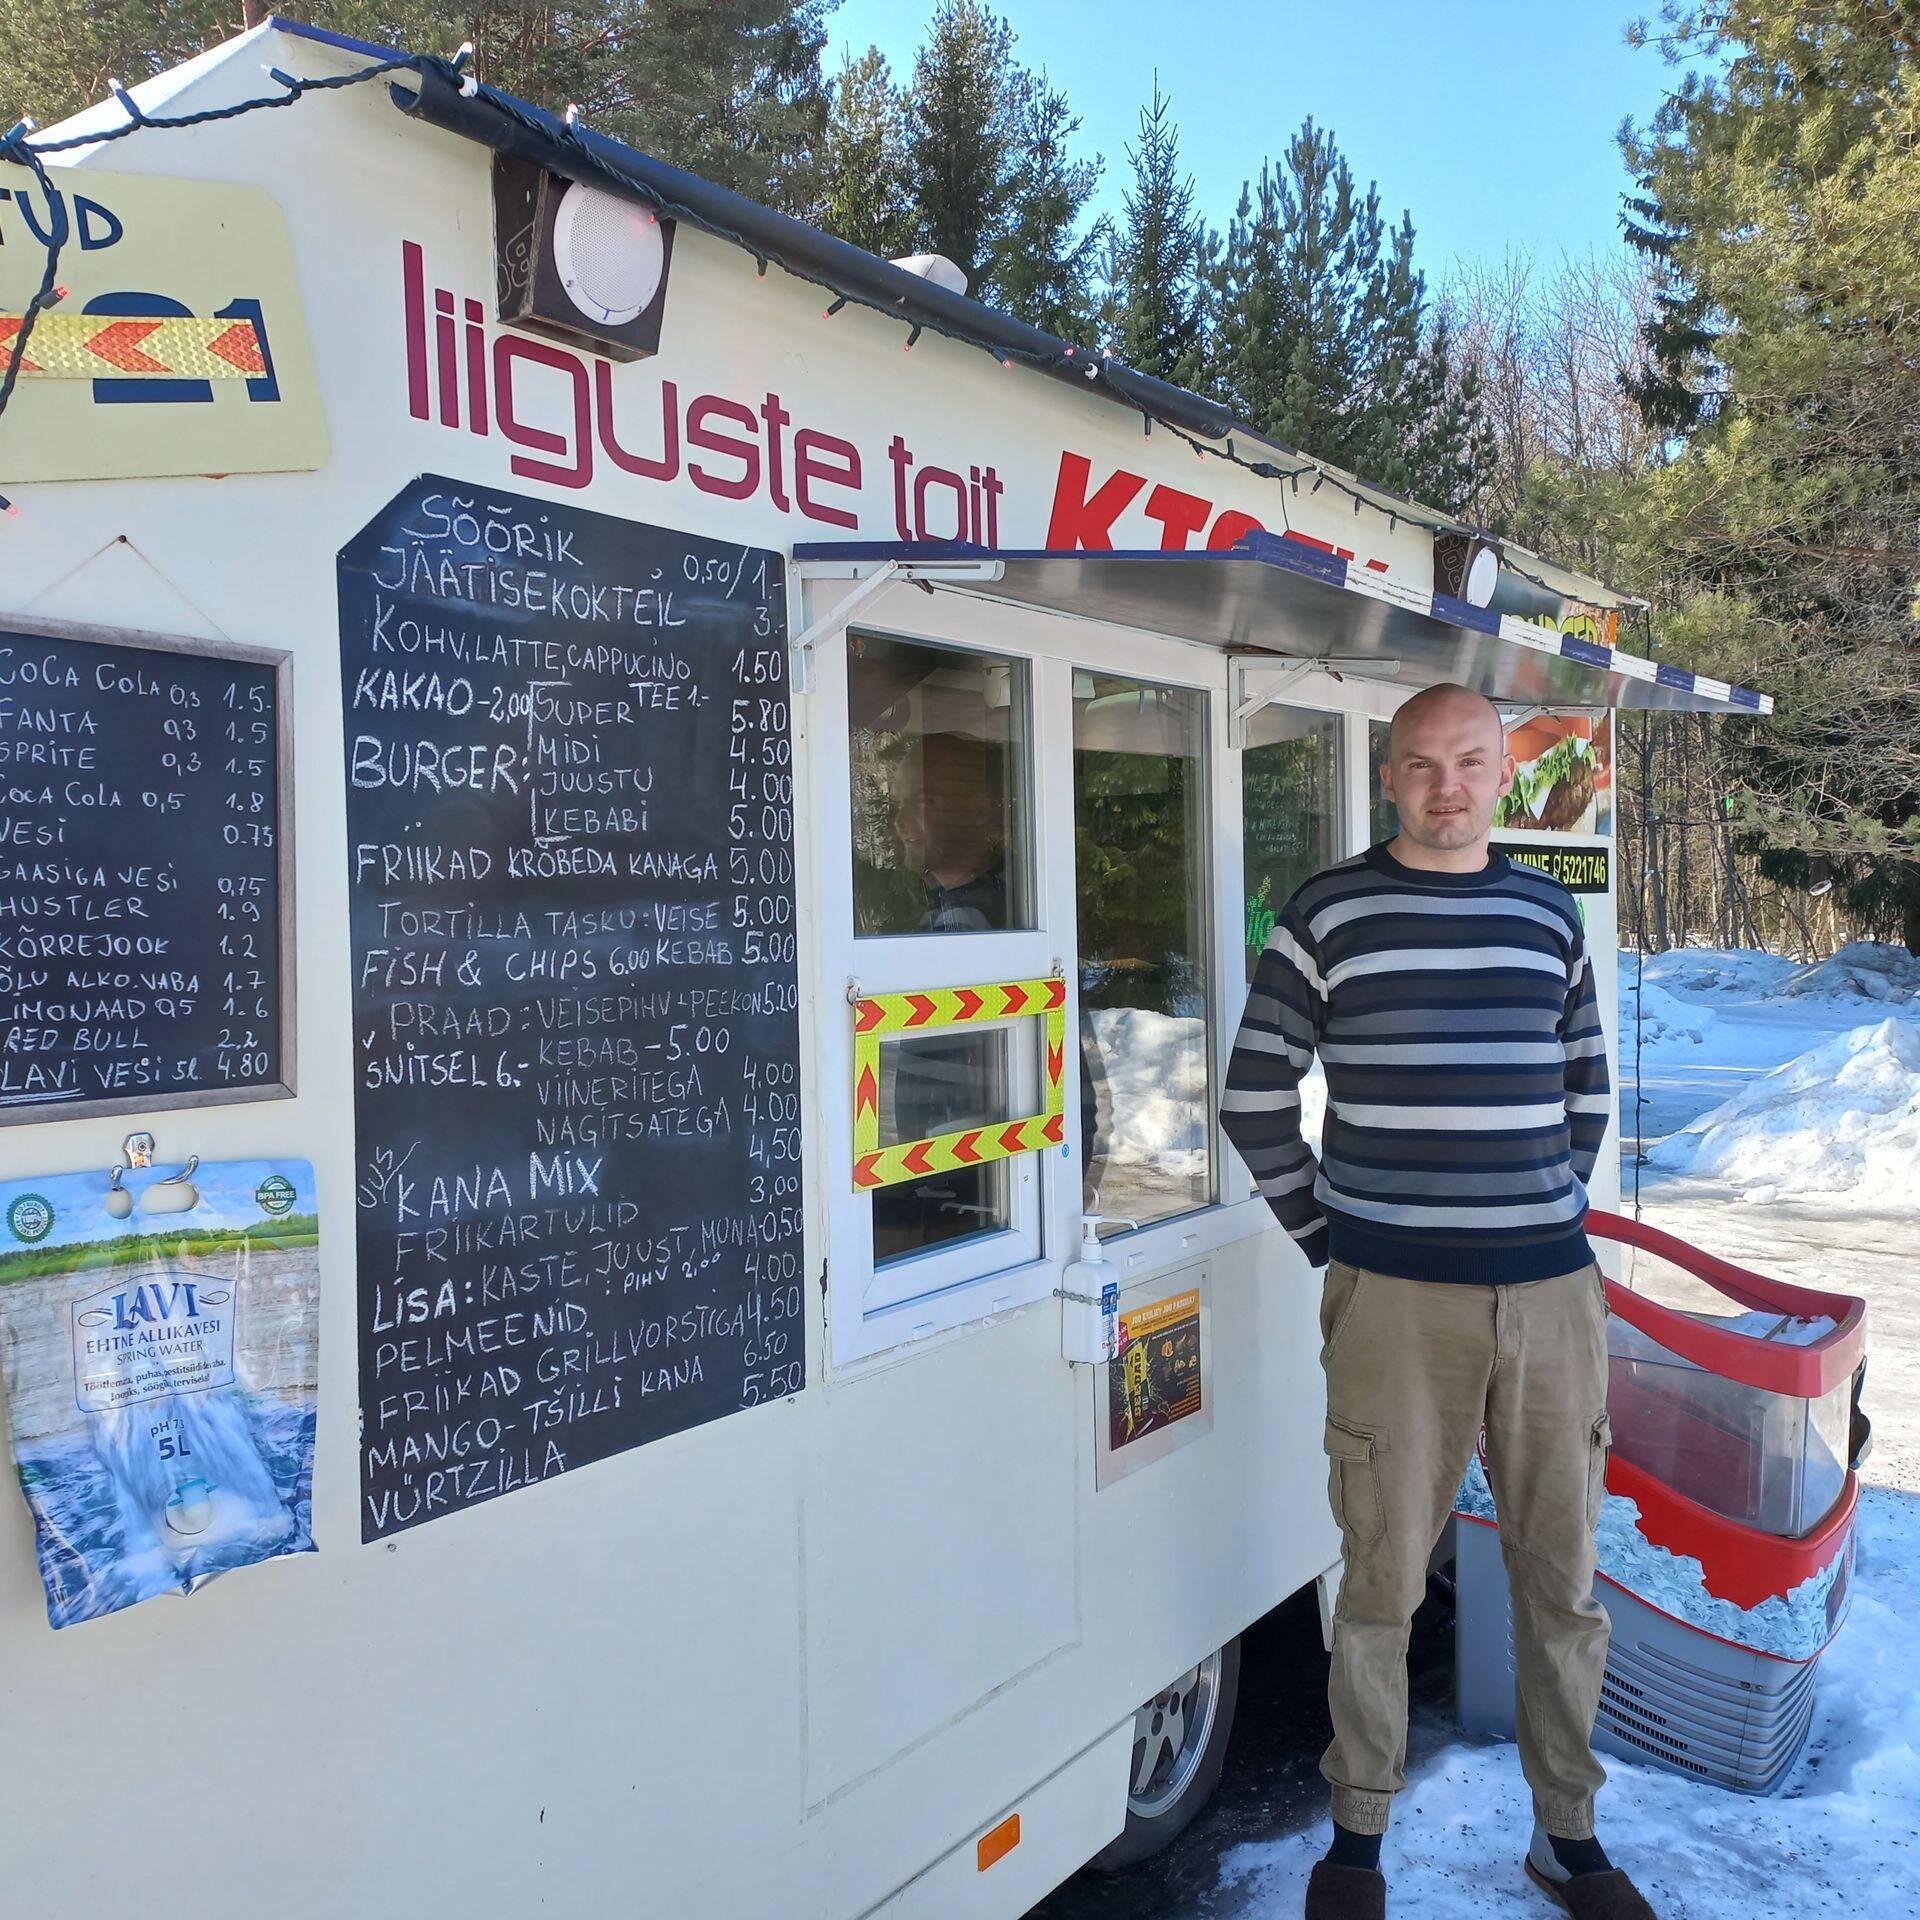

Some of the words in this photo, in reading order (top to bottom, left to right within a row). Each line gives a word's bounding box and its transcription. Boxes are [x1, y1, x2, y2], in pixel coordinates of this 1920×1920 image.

[402, 239, 862, 531] liiguste
[887, 434, 1003, 550] toit
[628, 682, 679, 710] TEE
[732, 649, 782, 684] 1.50
[534, 688, 634, 724] SUPER
[731, 699, 786, 733] 5.80
[161, 752, 201, 777] 0,3
[729, 738, 790, 766] 4.50
[540, 768, 653, 795] JUUSTU
[729, 767, 793, 805] 4.00
[142, 792, 186, 814] 0,5
[225, 792, 264, 812] 1.8
[728, 804, 792, 842] 5.00
[356, 844, 491, 886] FRIIKAD
[629, 849, 718, 883] KANAGA
[730, 847, 792, 886] 5.00
[1562, 855, 1606, 884] 5221746
[0, 894, 149, 920] HUSTLER
[217, 901, 260, 922] 1.9
[378, 901, 532, 939] TORTILLA
[654, 901, 720, 931] VEISE
[732, 894, 790, 929] 5.00
[219, 934, 258, 959] 1.2
[360, 947, 447, 989] FISH
[458, 950, 482, 986] &
[506, 949, 596, 981] CHIPS
[656, 937, 732, 965] KEBAB
[742, 931, 795, 965] 5.00
[223, 970, 265, 994] 1.7
[760, 981, 797, 1016] 5.20
[223, 997, 268, 1018] 1.6
[4, 1026, 59, 1053] RED
[73, 1027, 149, 1052] BULL
[539, 1036, 639, 1067] KEBAB
[217, 1051, 269, 1080] 4.80
[743, 1054, 793, 1090] 4.00
[743, 1093, 797, 1125] 4.00
[397, 1164, 513, 1223] KANA
[529, 1150, 602, 1199] MIX
[749, 1128, 801, 1168] 4,50
[749, 1176, 799, 1203] 3,00
[276, 1190, 295, 1198] FREE
[111, 1282, 200, 1330] LAVI
[746, 1287, 800, 1342] 4.50
[86, 1333, 134, 1354] EHTNE
[138, 1319, 221, 1345] ALLIKAVESI
[117, 1346, 156, 1366] SPRING
[158, 1340, 203, 1357] WATER
[379, 1367, 521, 1429] FRIIKAD
[742, 1334, 787, 1367] 6.50
[641, 1356, 704, 1397] KANA
[741, 1361, 801, 1409] 5.50
[150, 1420, 170, 1438] pH
